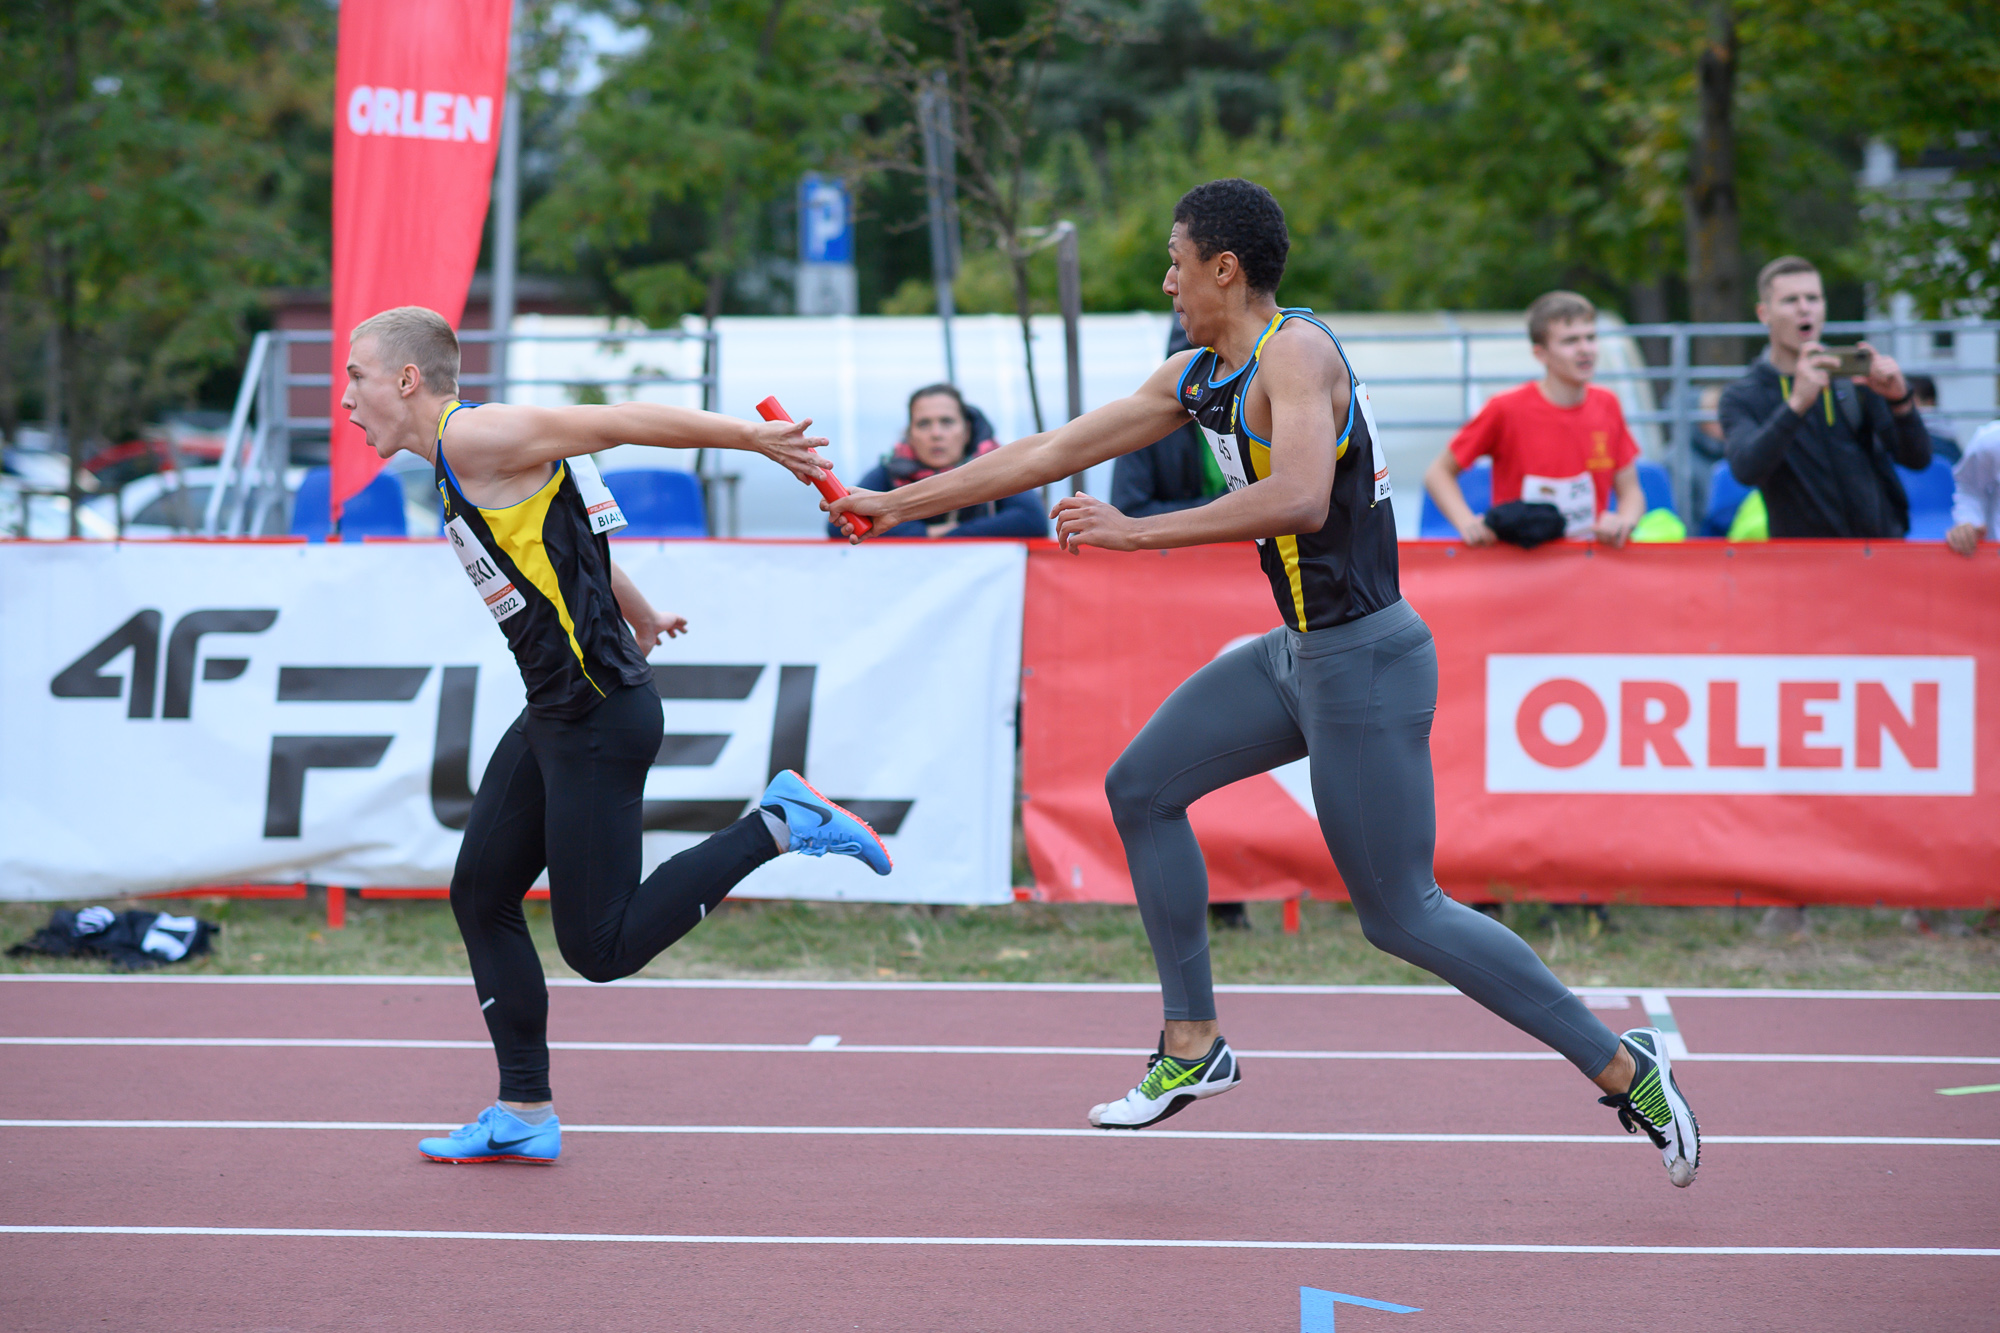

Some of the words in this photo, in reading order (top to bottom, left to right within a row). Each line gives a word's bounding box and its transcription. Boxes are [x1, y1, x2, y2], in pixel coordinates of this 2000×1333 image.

[348, 84, 493, 144] ORLEN
[809, 187, 845, 255] P
[1217, 436, 1232, 461] 45
[496, 597, 519, 616] 2022
[51, 609, 279, 719] 4F
[1515, 677, 1939, 769] ORLEN
